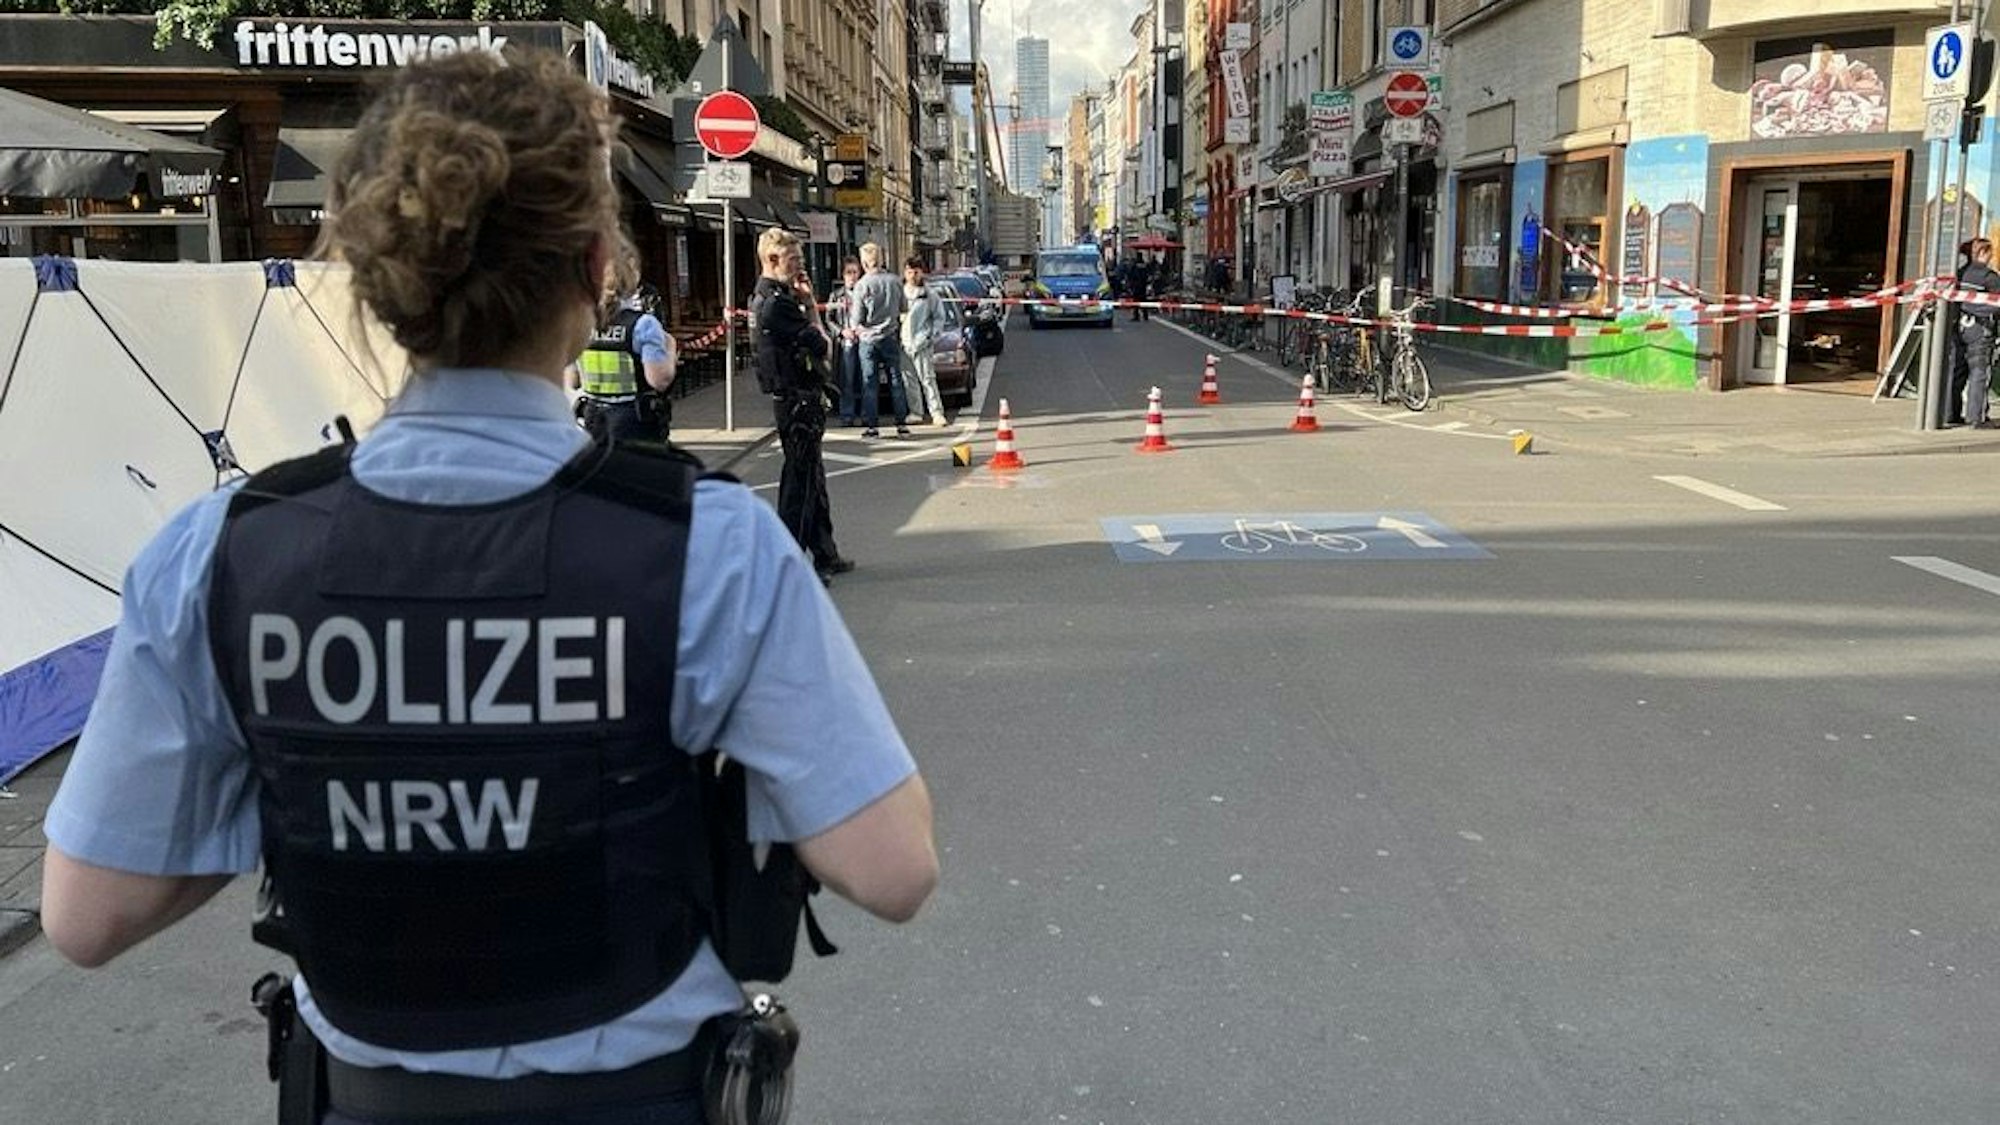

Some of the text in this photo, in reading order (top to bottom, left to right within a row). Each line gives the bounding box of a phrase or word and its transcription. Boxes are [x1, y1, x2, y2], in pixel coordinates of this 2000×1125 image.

[234, 21, 508, 67] frittenwerk
[1932, 82, 1956, 95] ZONE
[1312, 150, 1347, 162] Pizza
[1317, 138, 1343, 150] Mini
[249, 613, 625, 724] POLIZEI
[327, 778, 540, 852] NRW
